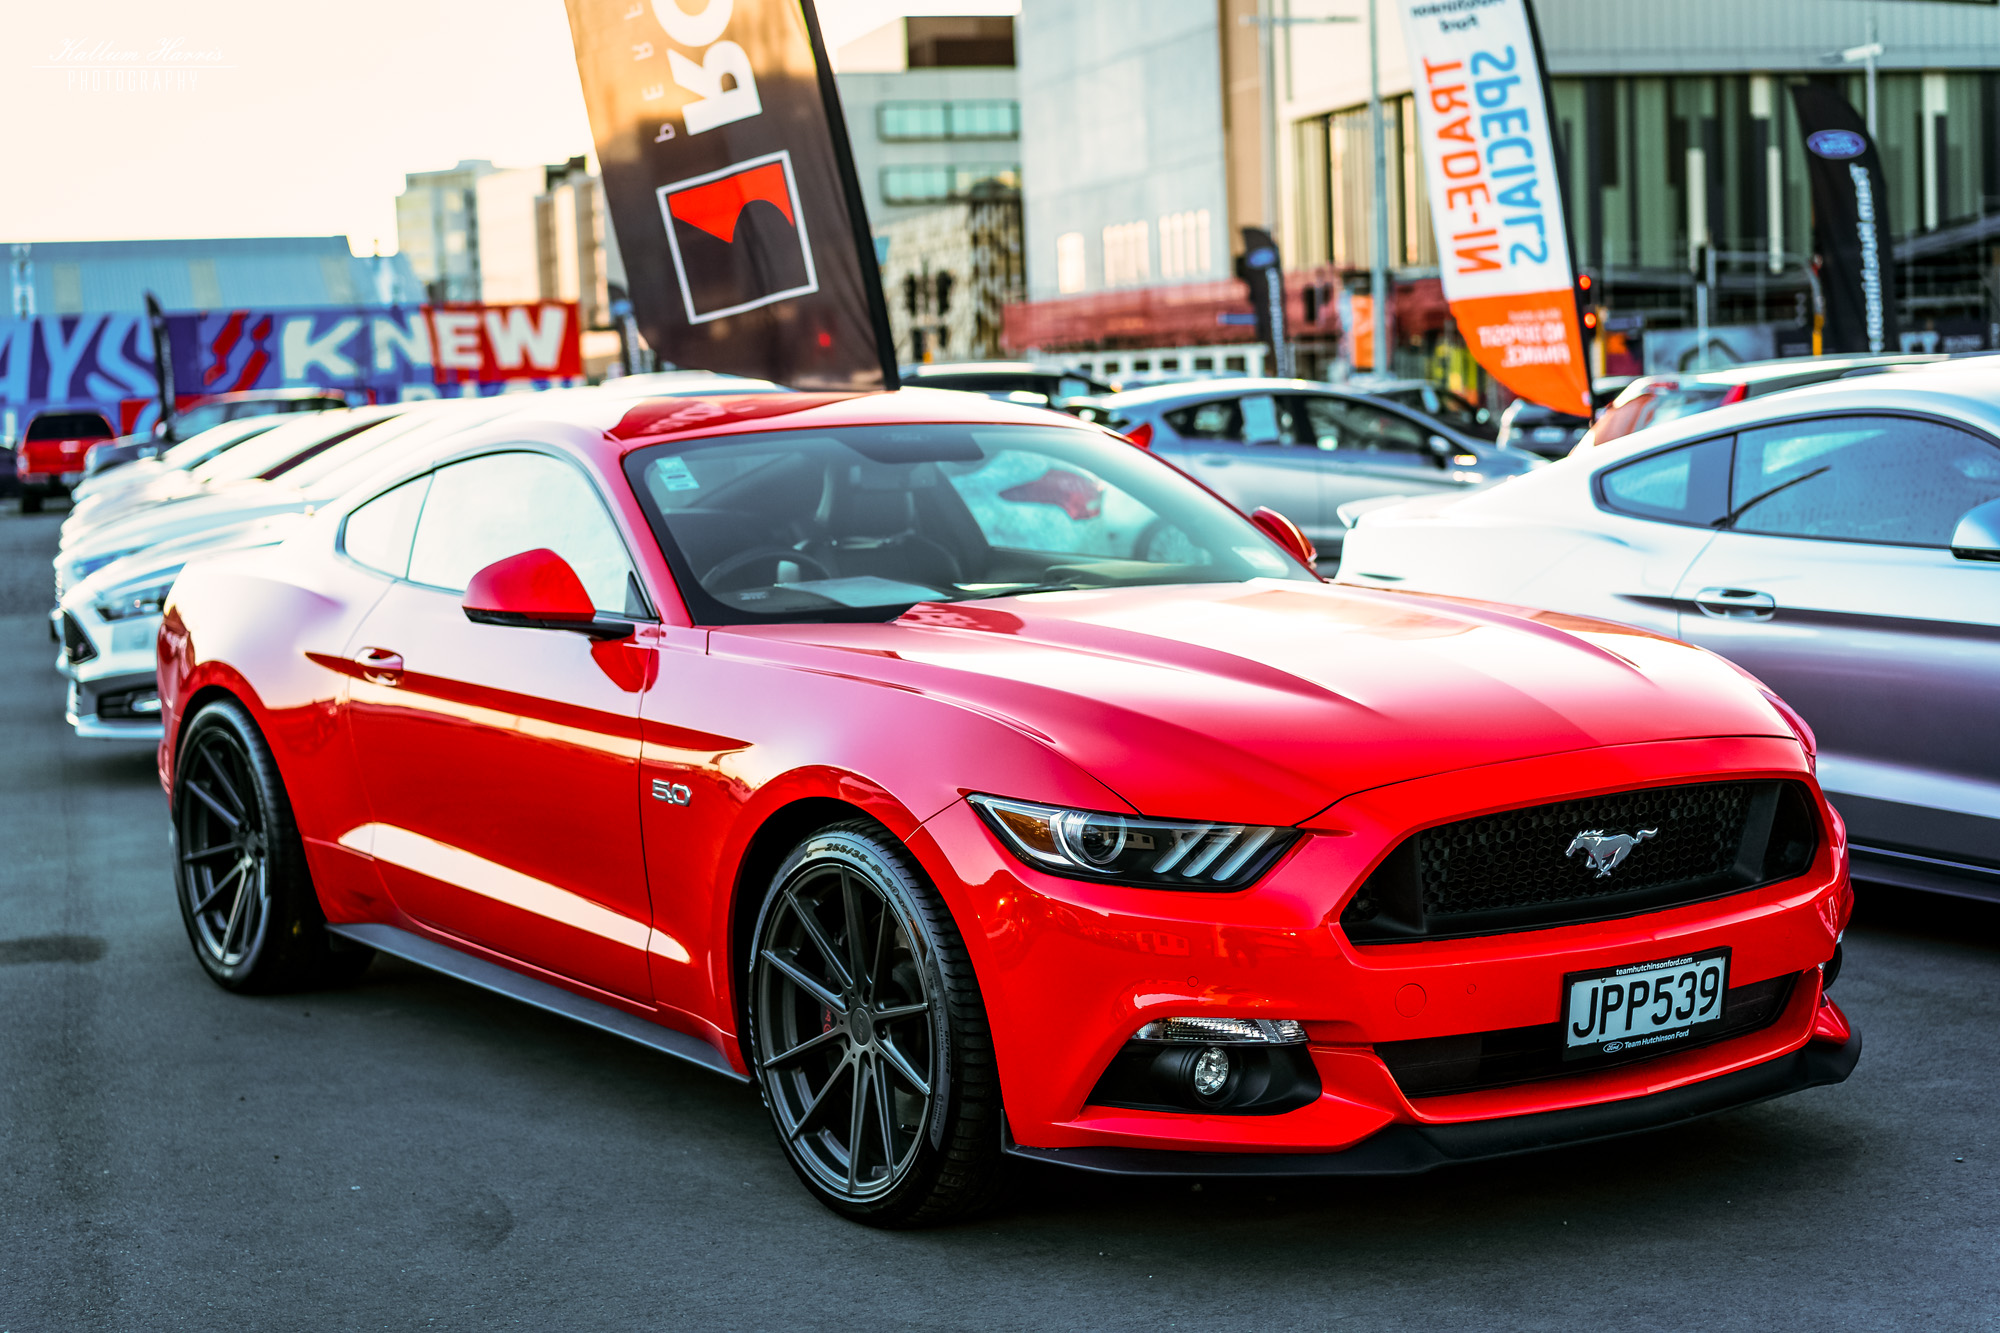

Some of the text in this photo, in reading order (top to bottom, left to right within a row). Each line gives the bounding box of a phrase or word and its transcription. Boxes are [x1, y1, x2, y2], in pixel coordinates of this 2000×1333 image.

[281, 306, 567, 381] KNEW
[652, 778, 692, 806] 5.0
[1615, 957, 1693, 976] teamhutchinsonford.com
[1572, 965, 1720, 1038] JPP539
[1624, 1029, 1690, 1049] Team Hutchinson Ford
